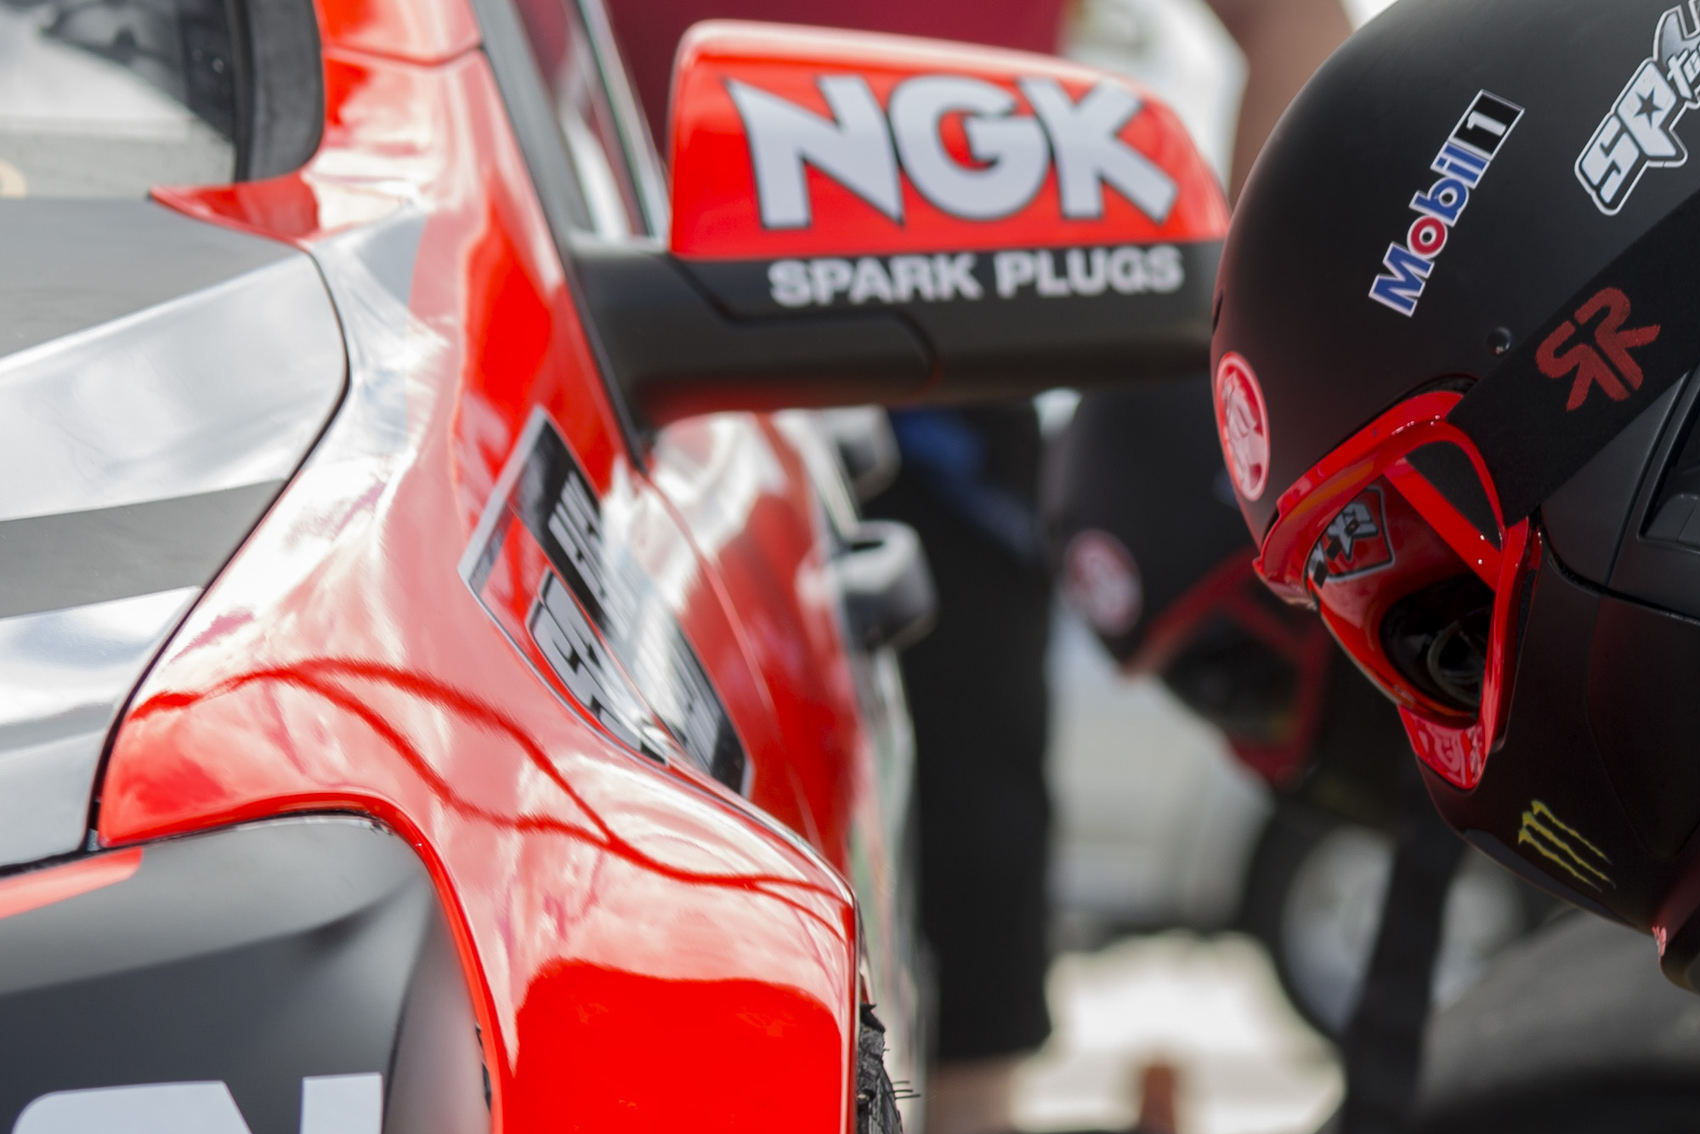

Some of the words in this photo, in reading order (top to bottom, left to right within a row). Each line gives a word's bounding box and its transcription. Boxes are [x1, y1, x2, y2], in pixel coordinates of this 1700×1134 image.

[724, 72, 1181, 229] NGK
[1368, 141, 1491, 317] Mobil
[768, 255, 980, 306] SPARK
[994, 245, 1184, 298] PLUGS
